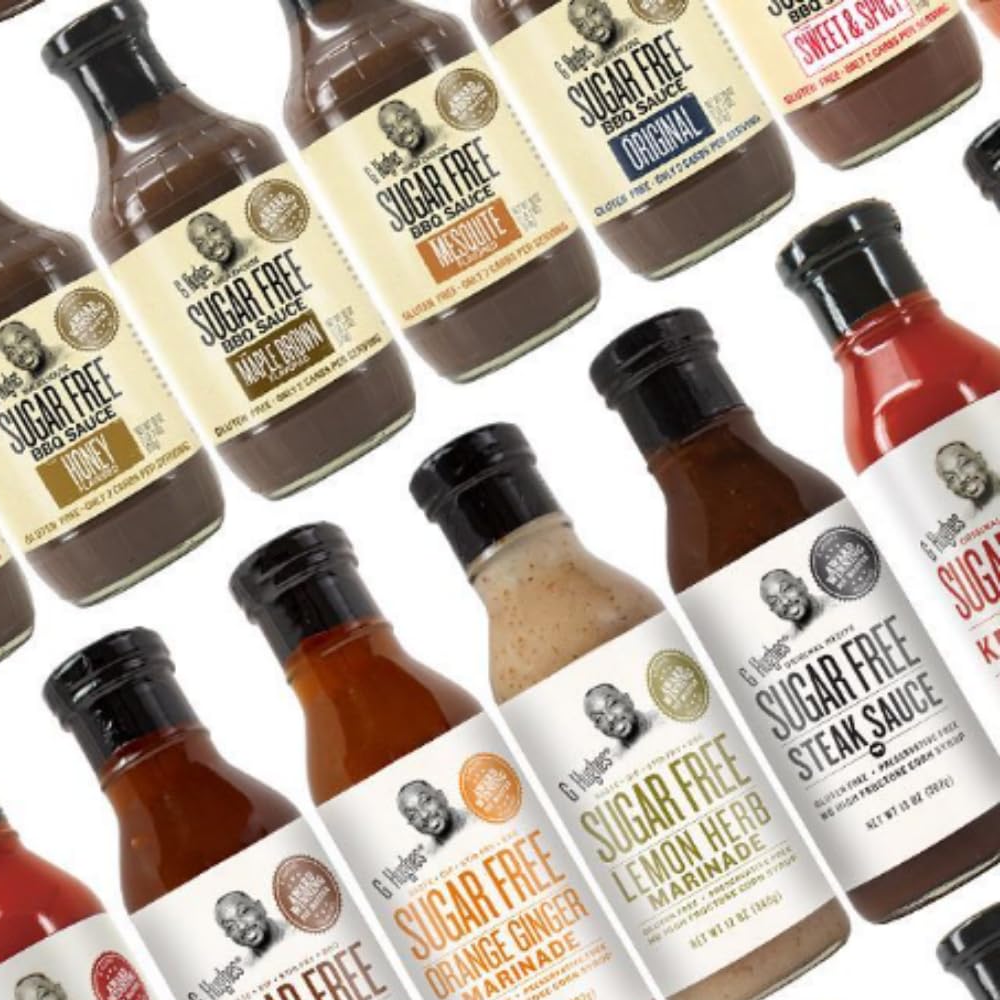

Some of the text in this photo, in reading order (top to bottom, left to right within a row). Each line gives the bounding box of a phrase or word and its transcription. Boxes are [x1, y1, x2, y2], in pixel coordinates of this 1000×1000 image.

[568, 59, 644, 126] SUGAR
[631, 30, 692, 90] FREE
[795, 8, 864, 64] SWEET &
[601, 108, 636, 135] BBQ
[636, 77, 686, 114] SAUCE
[622, 106, 702, 169] ORIGINAL
[377, 165, 452, 230] SUGAR
[440, 137, 498, 195] FREE
[429, 207, 505, 266] MESQUITE
[188, 278, 263, 345] SUGAR
[251, 249, 310, 308] FREE
[60, 357, 121, 416] FREE
[235, 344, 282, 385] MAPLE
[274, 320, 322, 364] BROWN
[61, 434, 114, 485] HONEY
[756, 616, 920, 740] SUGAR FREE
[788, 673, 942, 781] STEAK SAUCE
[580, 733, 752, 863] SUGAR FREE
[611, 791, 773, 904] LEMON HERB
[649, 834, 764, 910] MARINADE
[392, 871, 498, 962] SUGAR
[483, 829, 566, 909] FREE
[423, 887, 590, 1000] ORANGE GINGER
